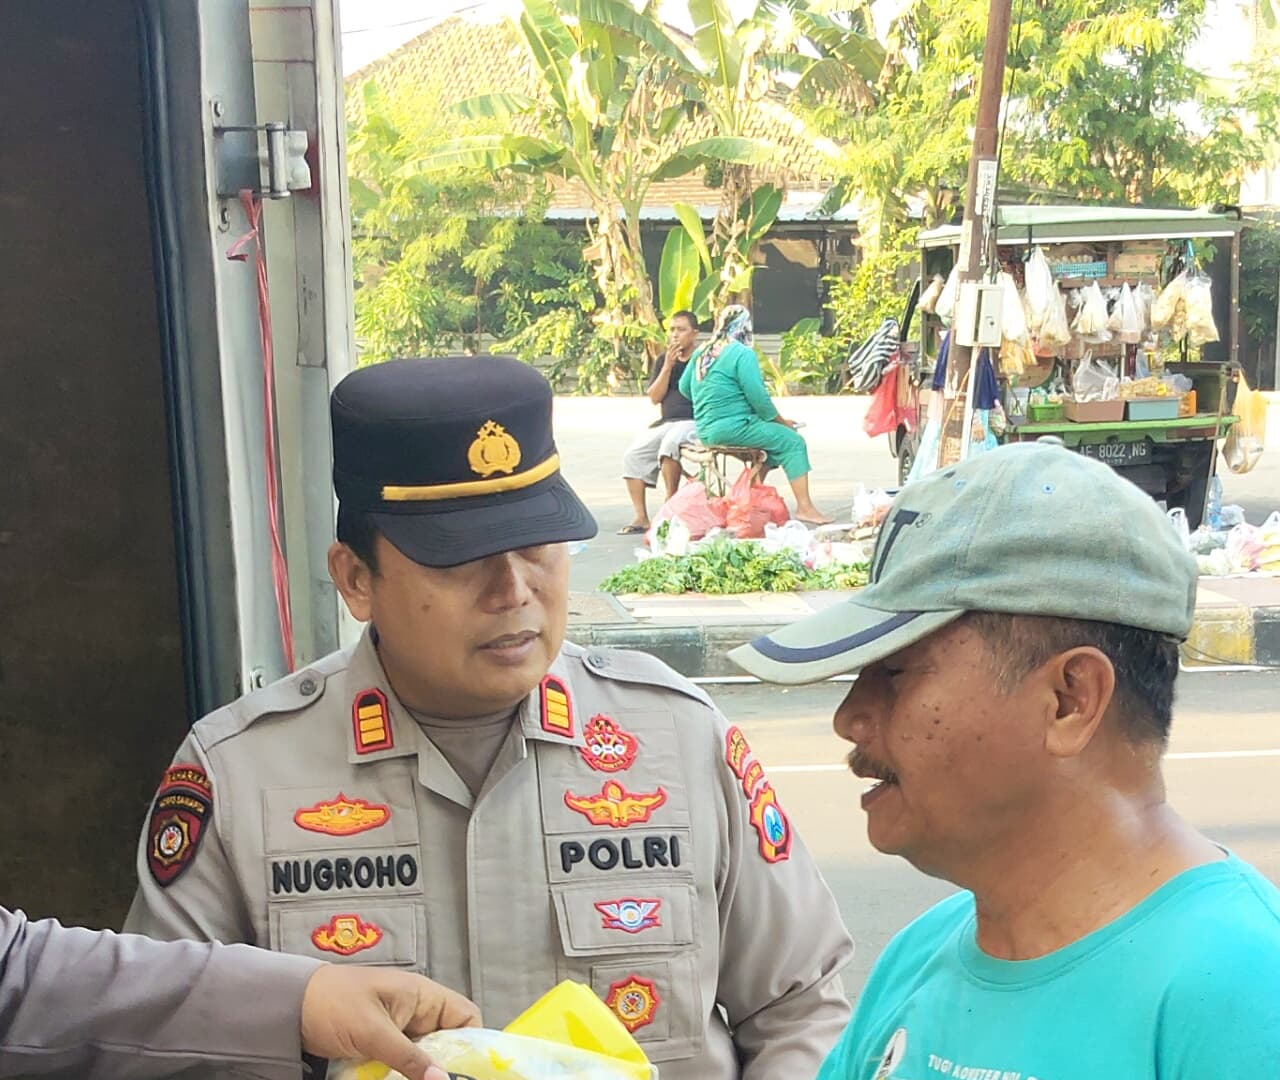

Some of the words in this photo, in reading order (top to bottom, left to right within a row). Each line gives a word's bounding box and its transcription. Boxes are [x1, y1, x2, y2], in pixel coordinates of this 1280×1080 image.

[1099, 444, 1125, 457] 8022
[1132, 443, 1146, 456] NG
[561, 835, 680, 873] POLRI
[272, 853, 418, 894] NUGROHO
